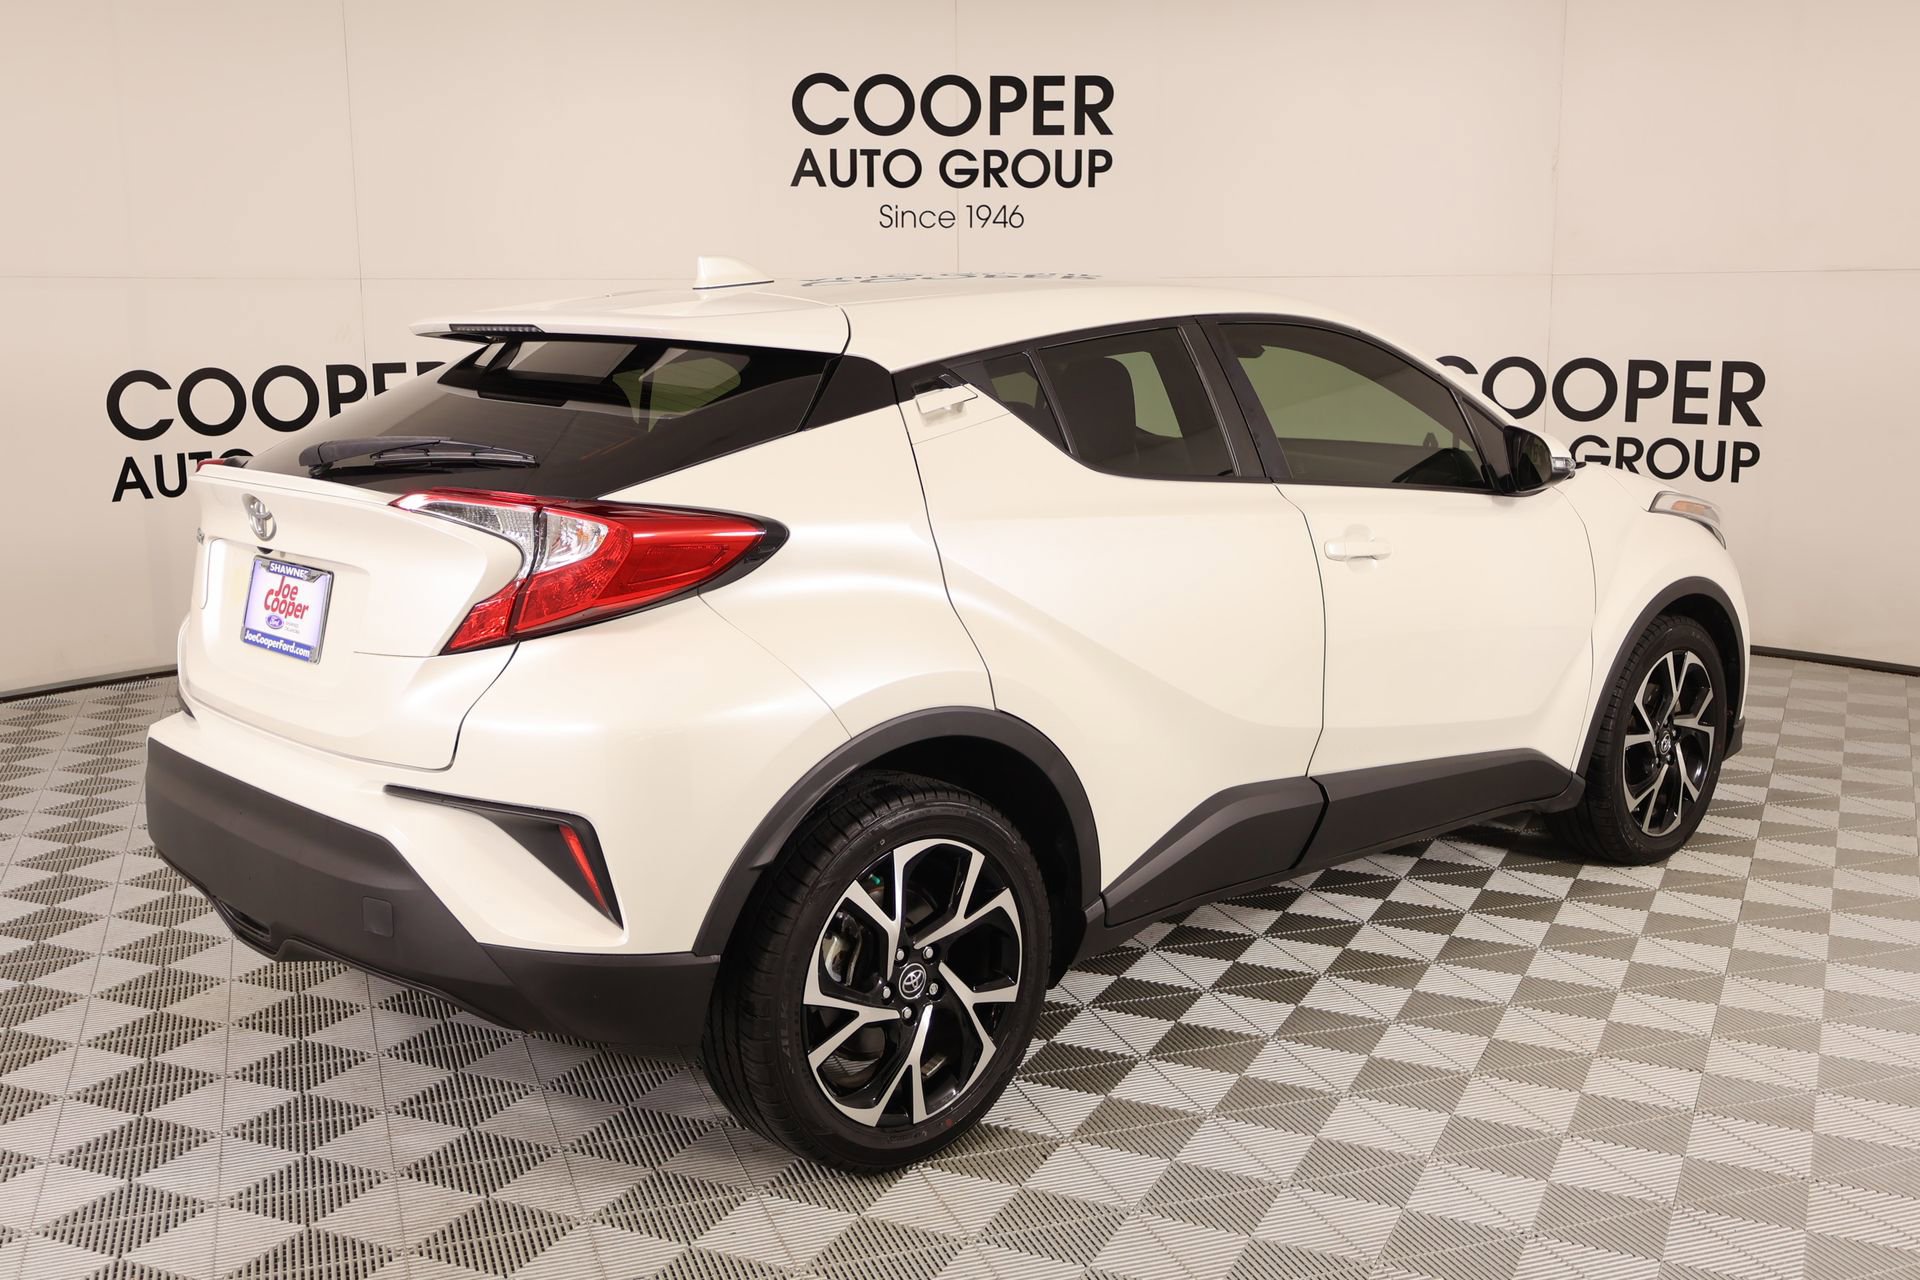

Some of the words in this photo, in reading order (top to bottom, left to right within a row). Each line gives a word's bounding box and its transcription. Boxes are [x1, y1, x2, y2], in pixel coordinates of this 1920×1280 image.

[791, 72, 1115, 137] COOPER
[790, 148, 923, 189] AUTO
[938, 148, 1113, 189] GROUP
[879, 204, 956, 229] Since
[965, 204, 1025, 229] 1946
[106, 361, 446, 441] COOP
[111, 448, 255, 503] AU
[1569, 434, 1761, 483] GROUP
[264, 588, 309, 620] Cooper
[275, 575, 299, 601] Joe
[244, 630, 311, 658] JoeCooperFord.com
